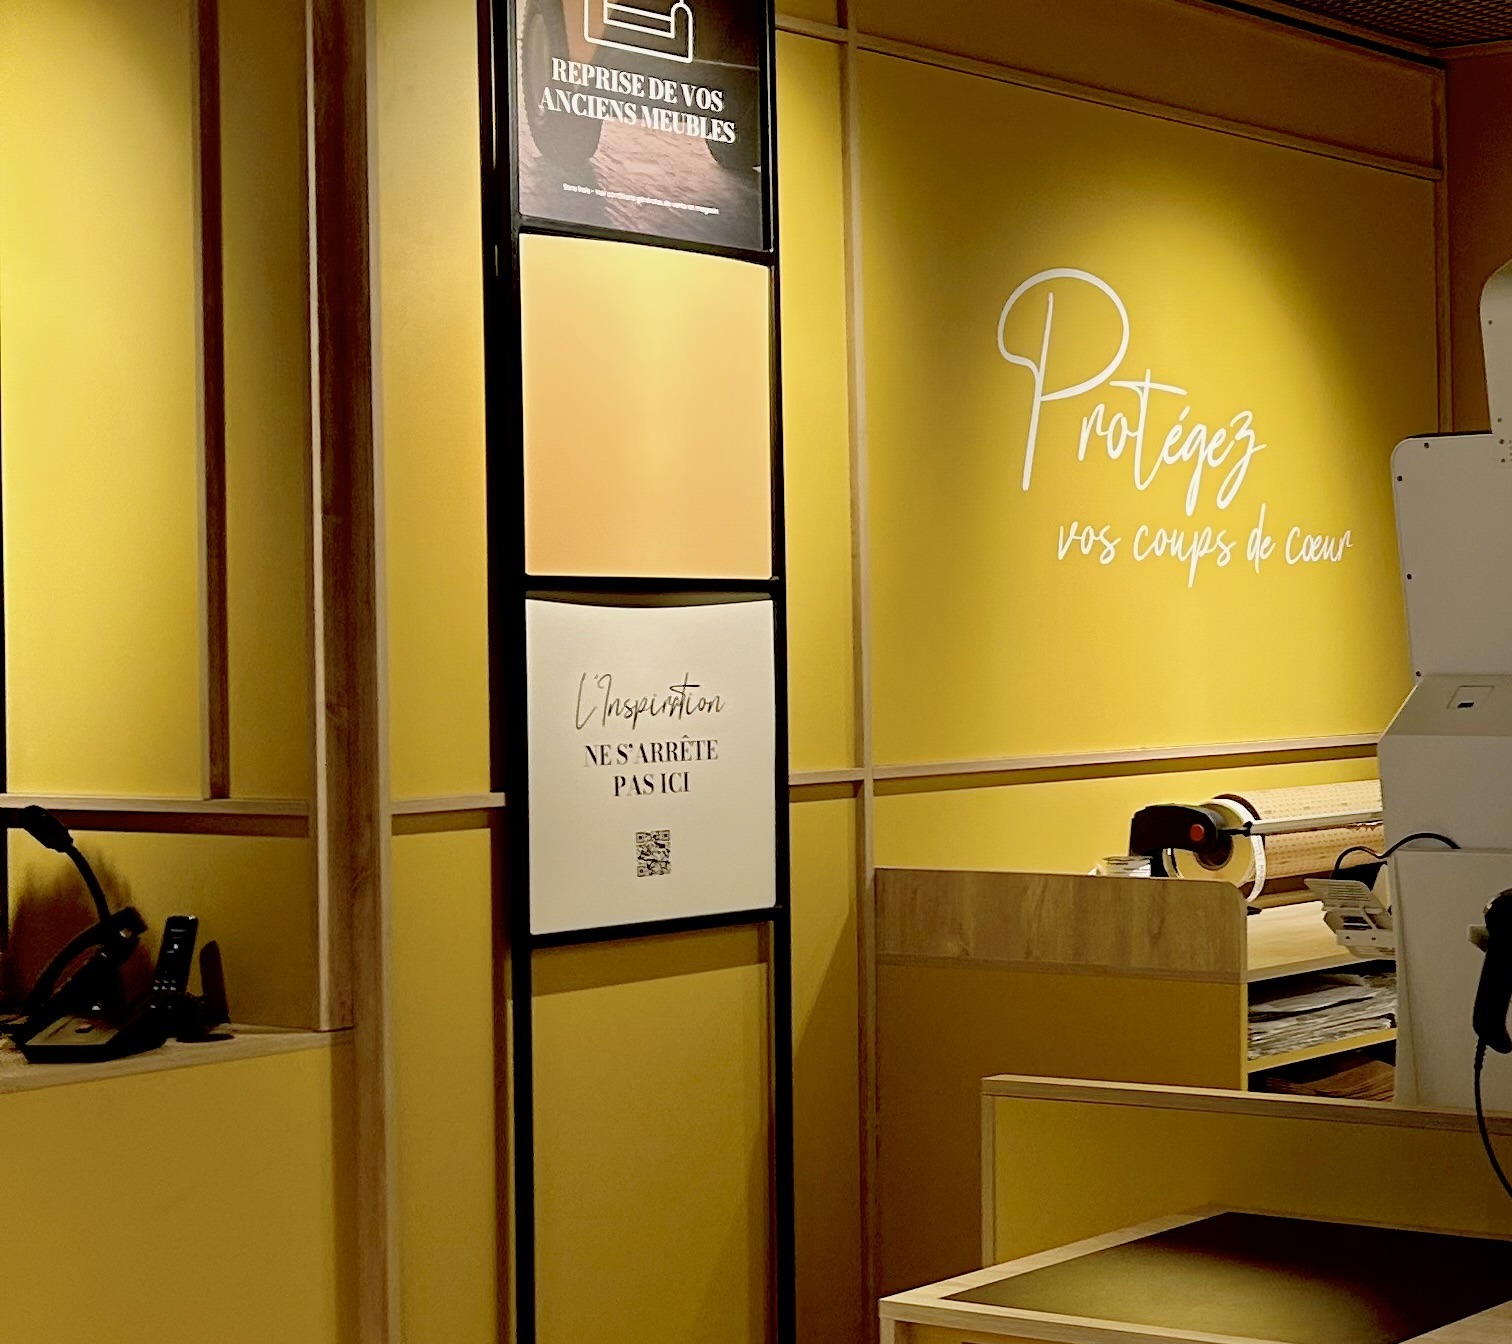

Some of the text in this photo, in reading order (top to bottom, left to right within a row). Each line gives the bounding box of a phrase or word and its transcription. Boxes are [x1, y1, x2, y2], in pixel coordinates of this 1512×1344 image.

[552, 57, 724, 112] REPRISE DE VOS
[539, 87, 736, 144] ANCIENS MEUBLES
[997, 267, 1267, 516] Protégez
[1057, 503, 1354, 588] vos coups de cœur
[576, 672, 726, 730] L'Inspiration
[584, 734, 719, 767] NE S'ARRÊTE
[614, 771, 691, 797] PAS ICI
